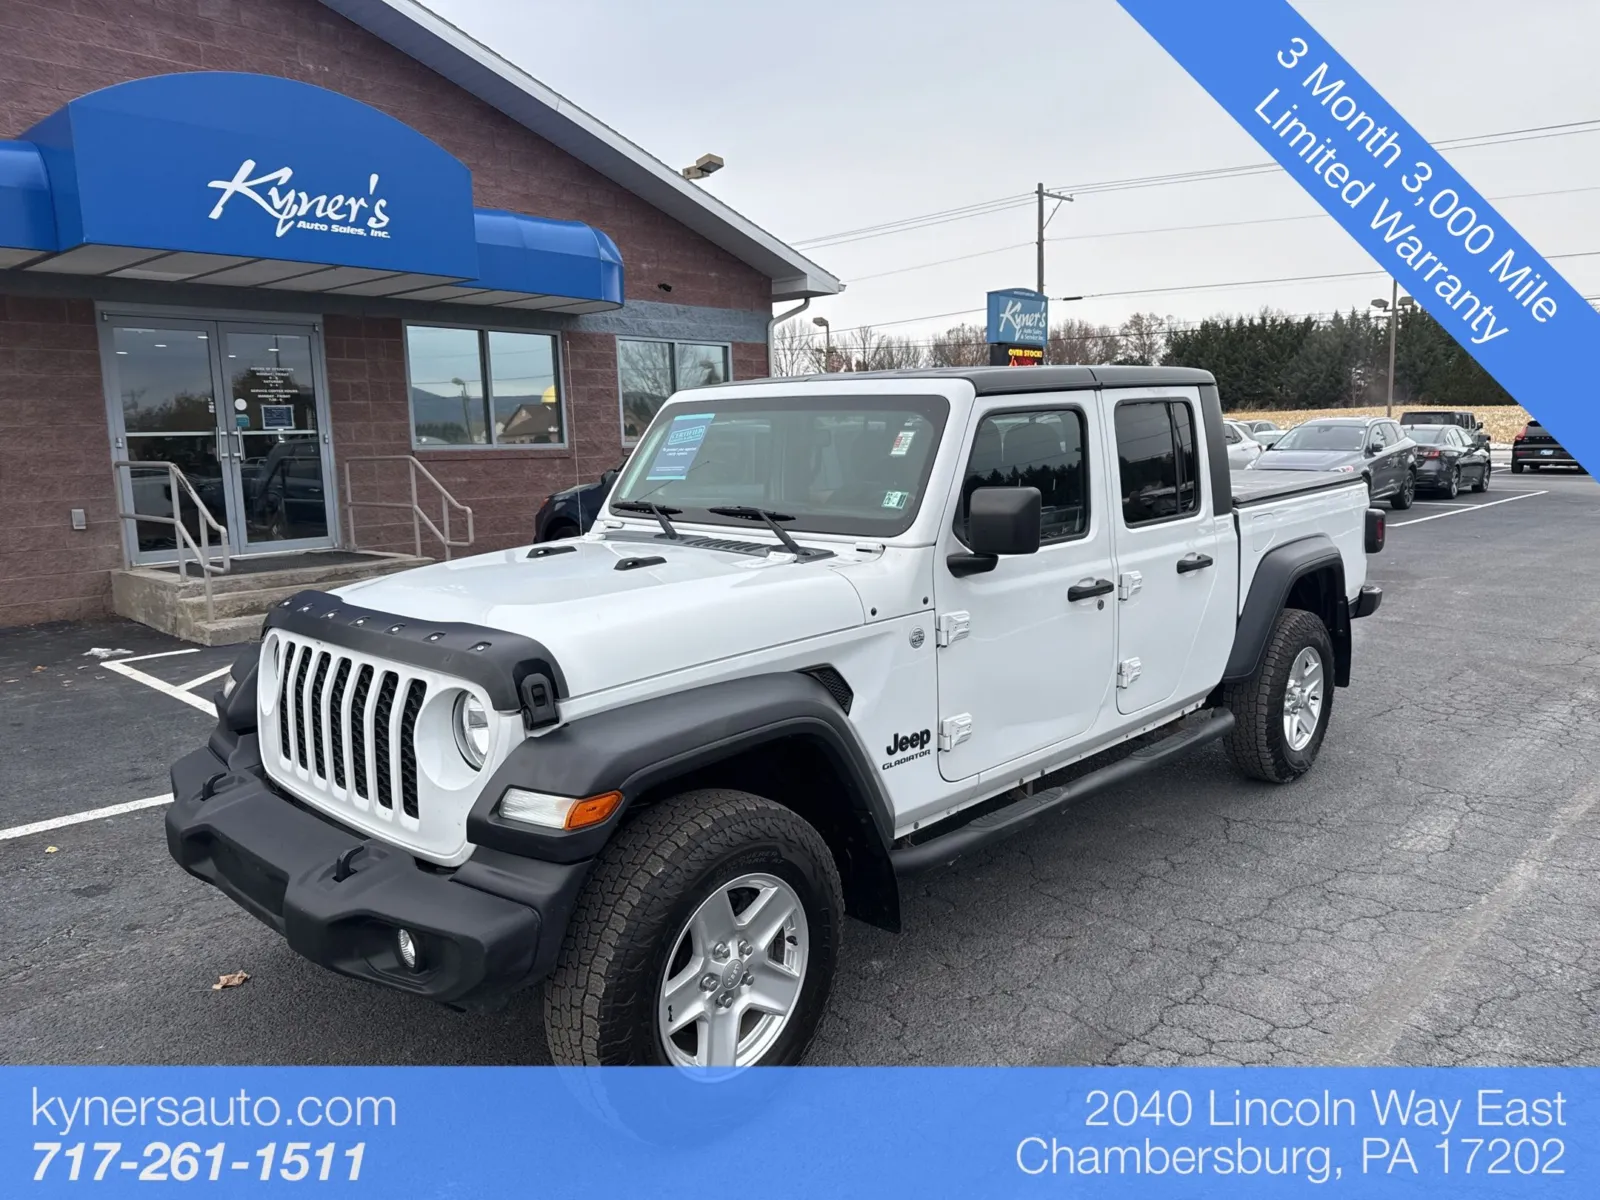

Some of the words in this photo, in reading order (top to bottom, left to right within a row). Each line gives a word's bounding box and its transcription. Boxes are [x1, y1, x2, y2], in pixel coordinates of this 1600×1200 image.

[207, 159, 390, 238] Kyner's
[296, 220, 328, 232] Auto
[331, 224, 367, 236] Sales,
[370, 229, 391, 238] Inc.
[999, 300, 1046, 341] Kyner's
[1008, 349, 1023, 357] OVER
[886, 728, 931, 756] Jeep
[882, 749, 931, 771] GLADIATOR
